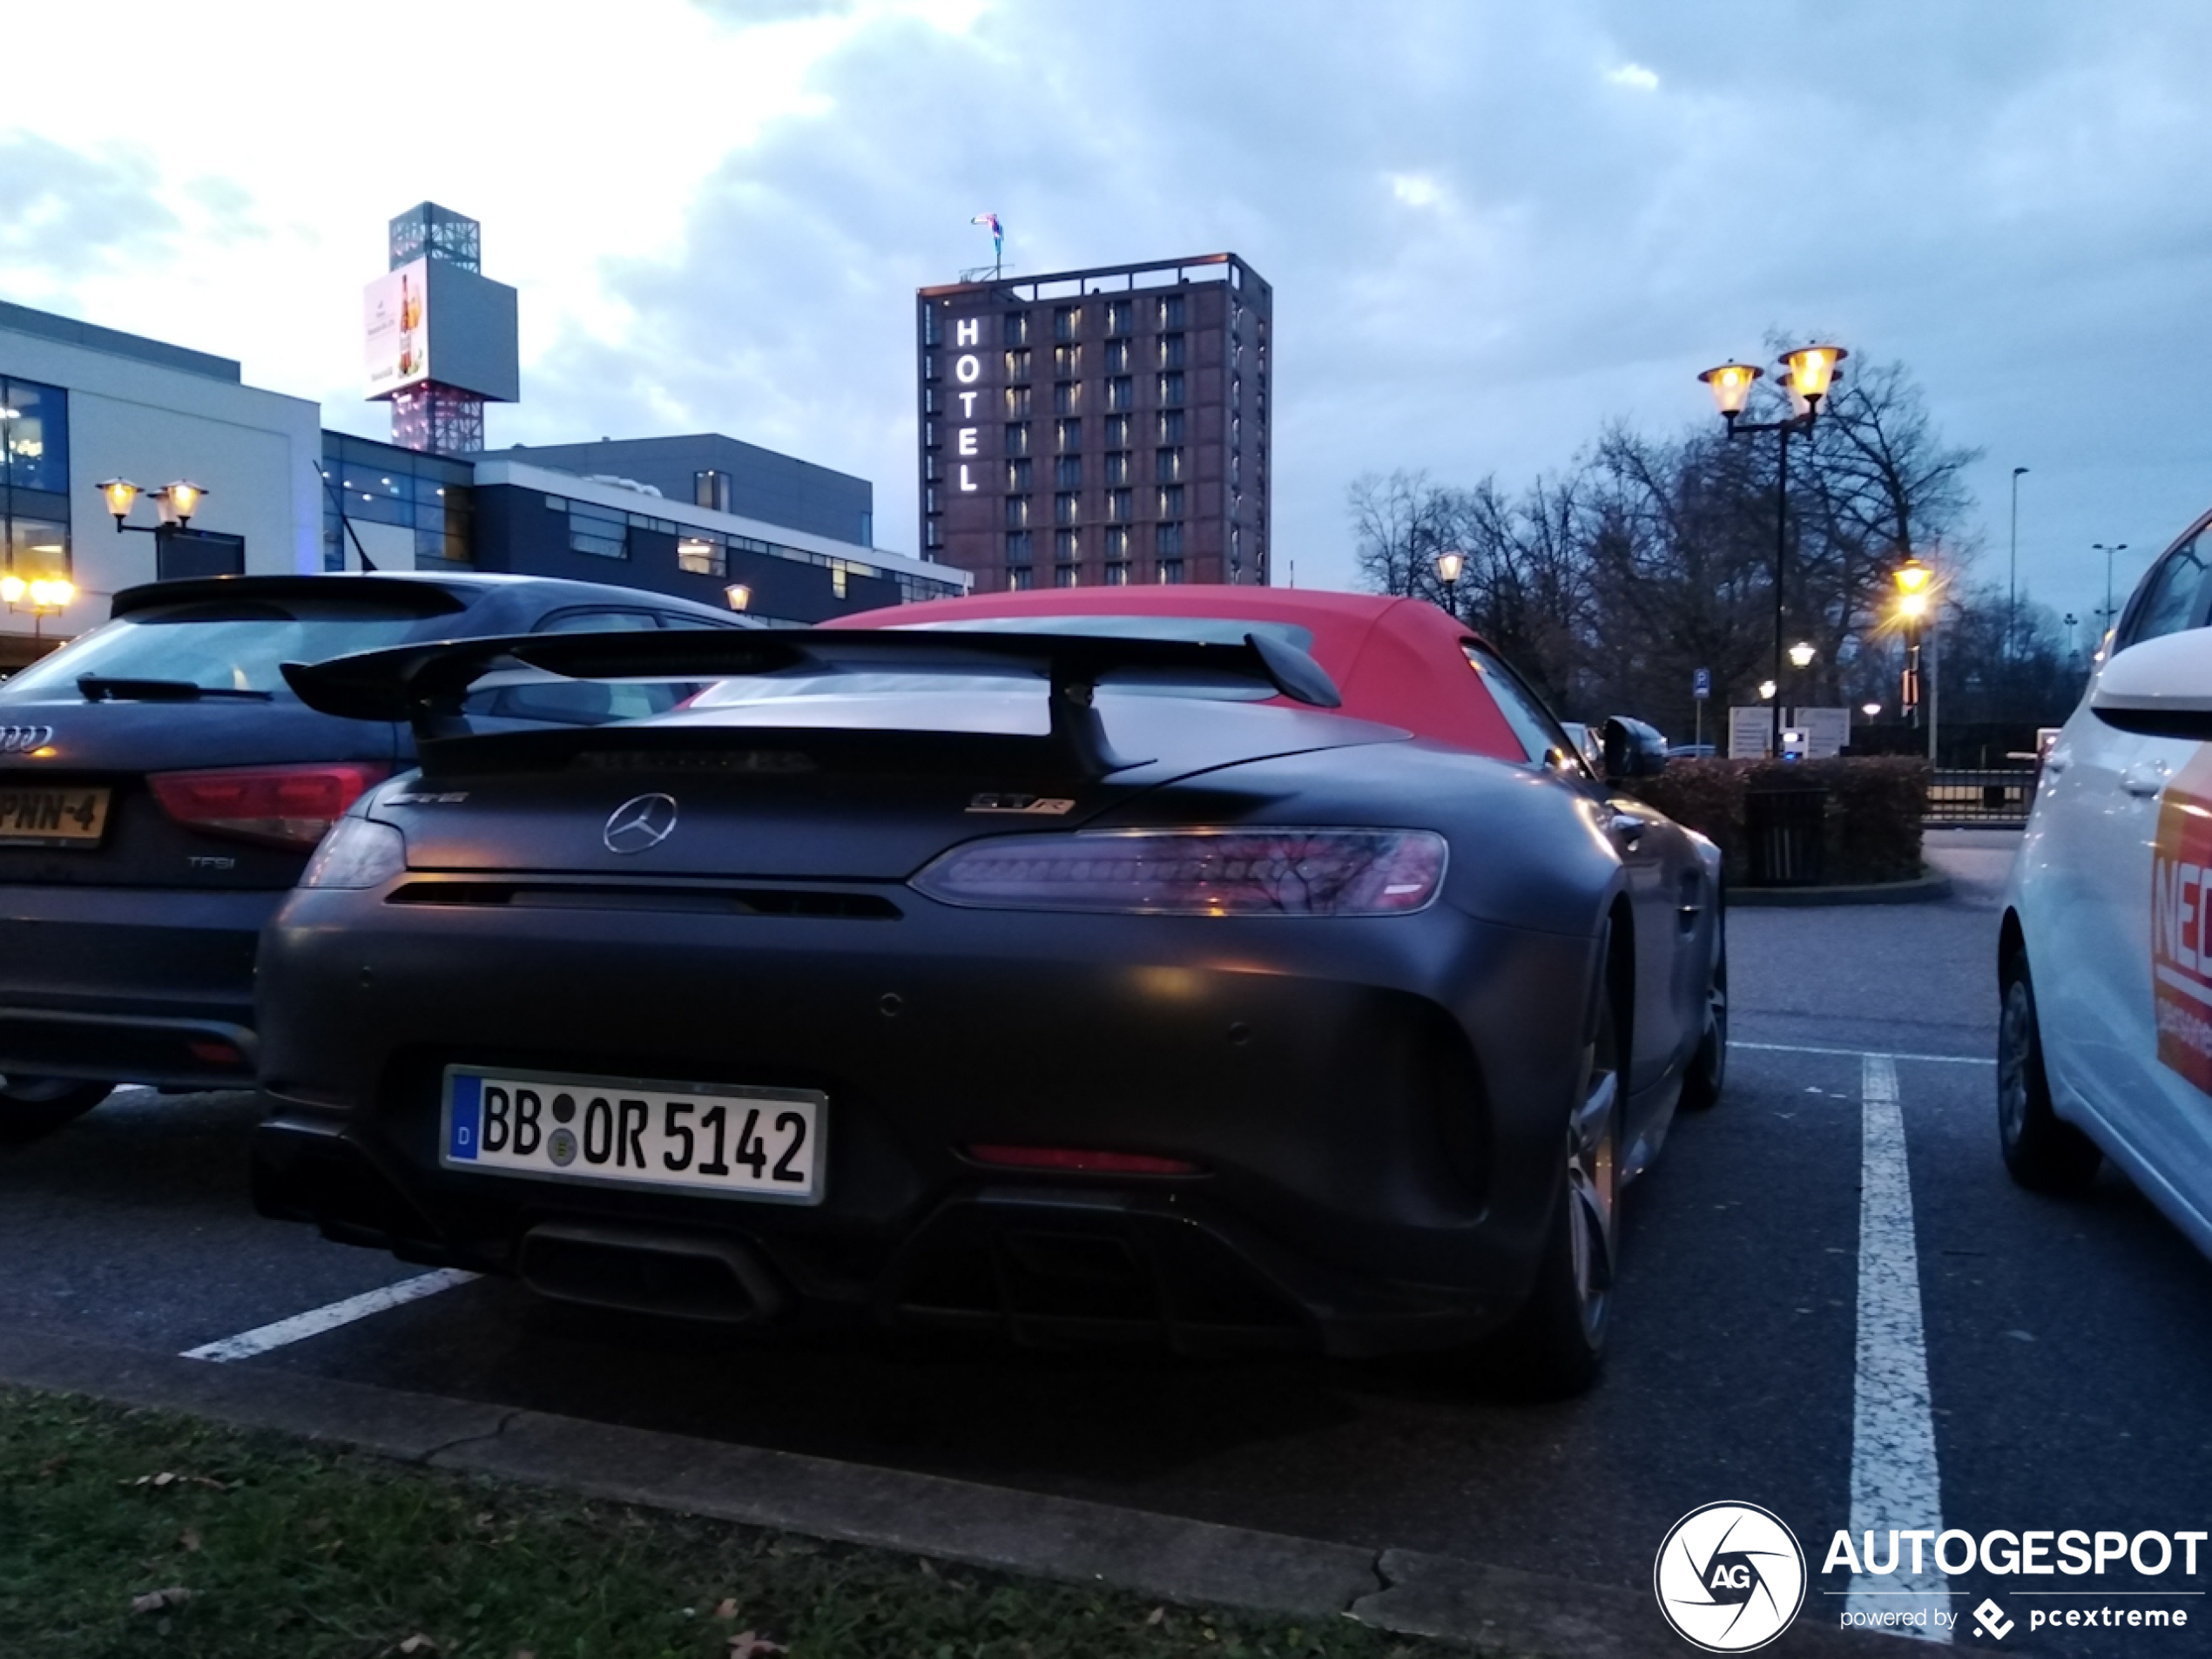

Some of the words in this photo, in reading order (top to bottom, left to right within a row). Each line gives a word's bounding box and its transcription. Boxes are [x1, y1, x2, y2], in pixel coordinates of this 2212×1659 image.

[956, 317, 980, 491] HOTEL
[1697, 671, 1706, 685] P
[458, 1126, 469, 1145] D
[482, 1086, 542, 1155] BB
[583, 1096, 649, 1168] OR
[663, 1102, 806, 1183] 5142
